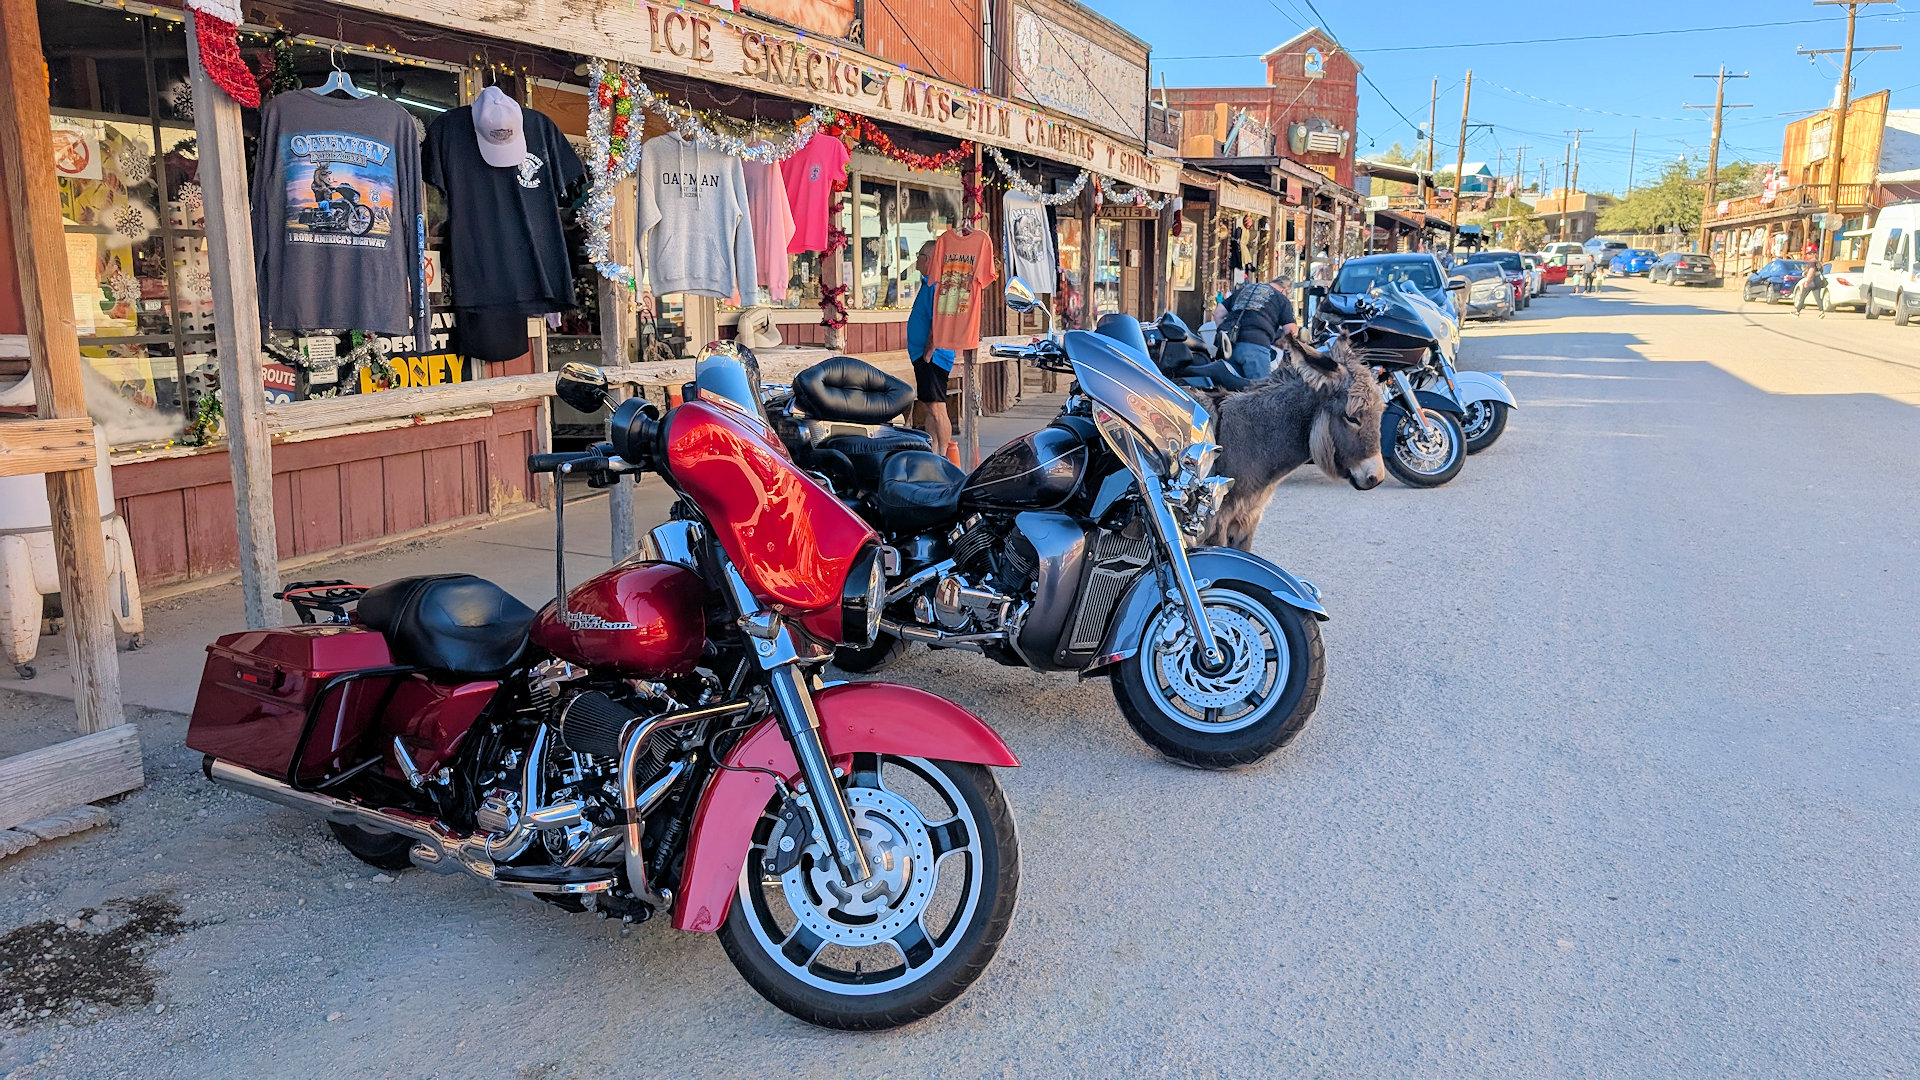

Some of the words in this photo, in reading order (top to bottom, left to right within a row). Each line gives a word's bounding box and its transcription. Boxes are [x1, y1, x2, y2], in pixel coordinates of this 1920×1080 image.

[647, 6, 713, 62] ICE
[741, 32, 860, 97] SNACKS
[901, 79, 950, 122] MAS
[967, 100, 1011, 139] FILM
[1025, 117, 1095, 162] CAMERAS
[1106, 145, 1116, 169] T
[1119, 151, 1161, 185] SHIRTS
[290, 134, 391, 166] OATMAN
[293, 232, 313, 243] RODE
[314, 233, 352, 246] AMERICA'S
[352, 236, 387, 248] HIGHWAY
[261, 367, 296, 387] ROUTE
